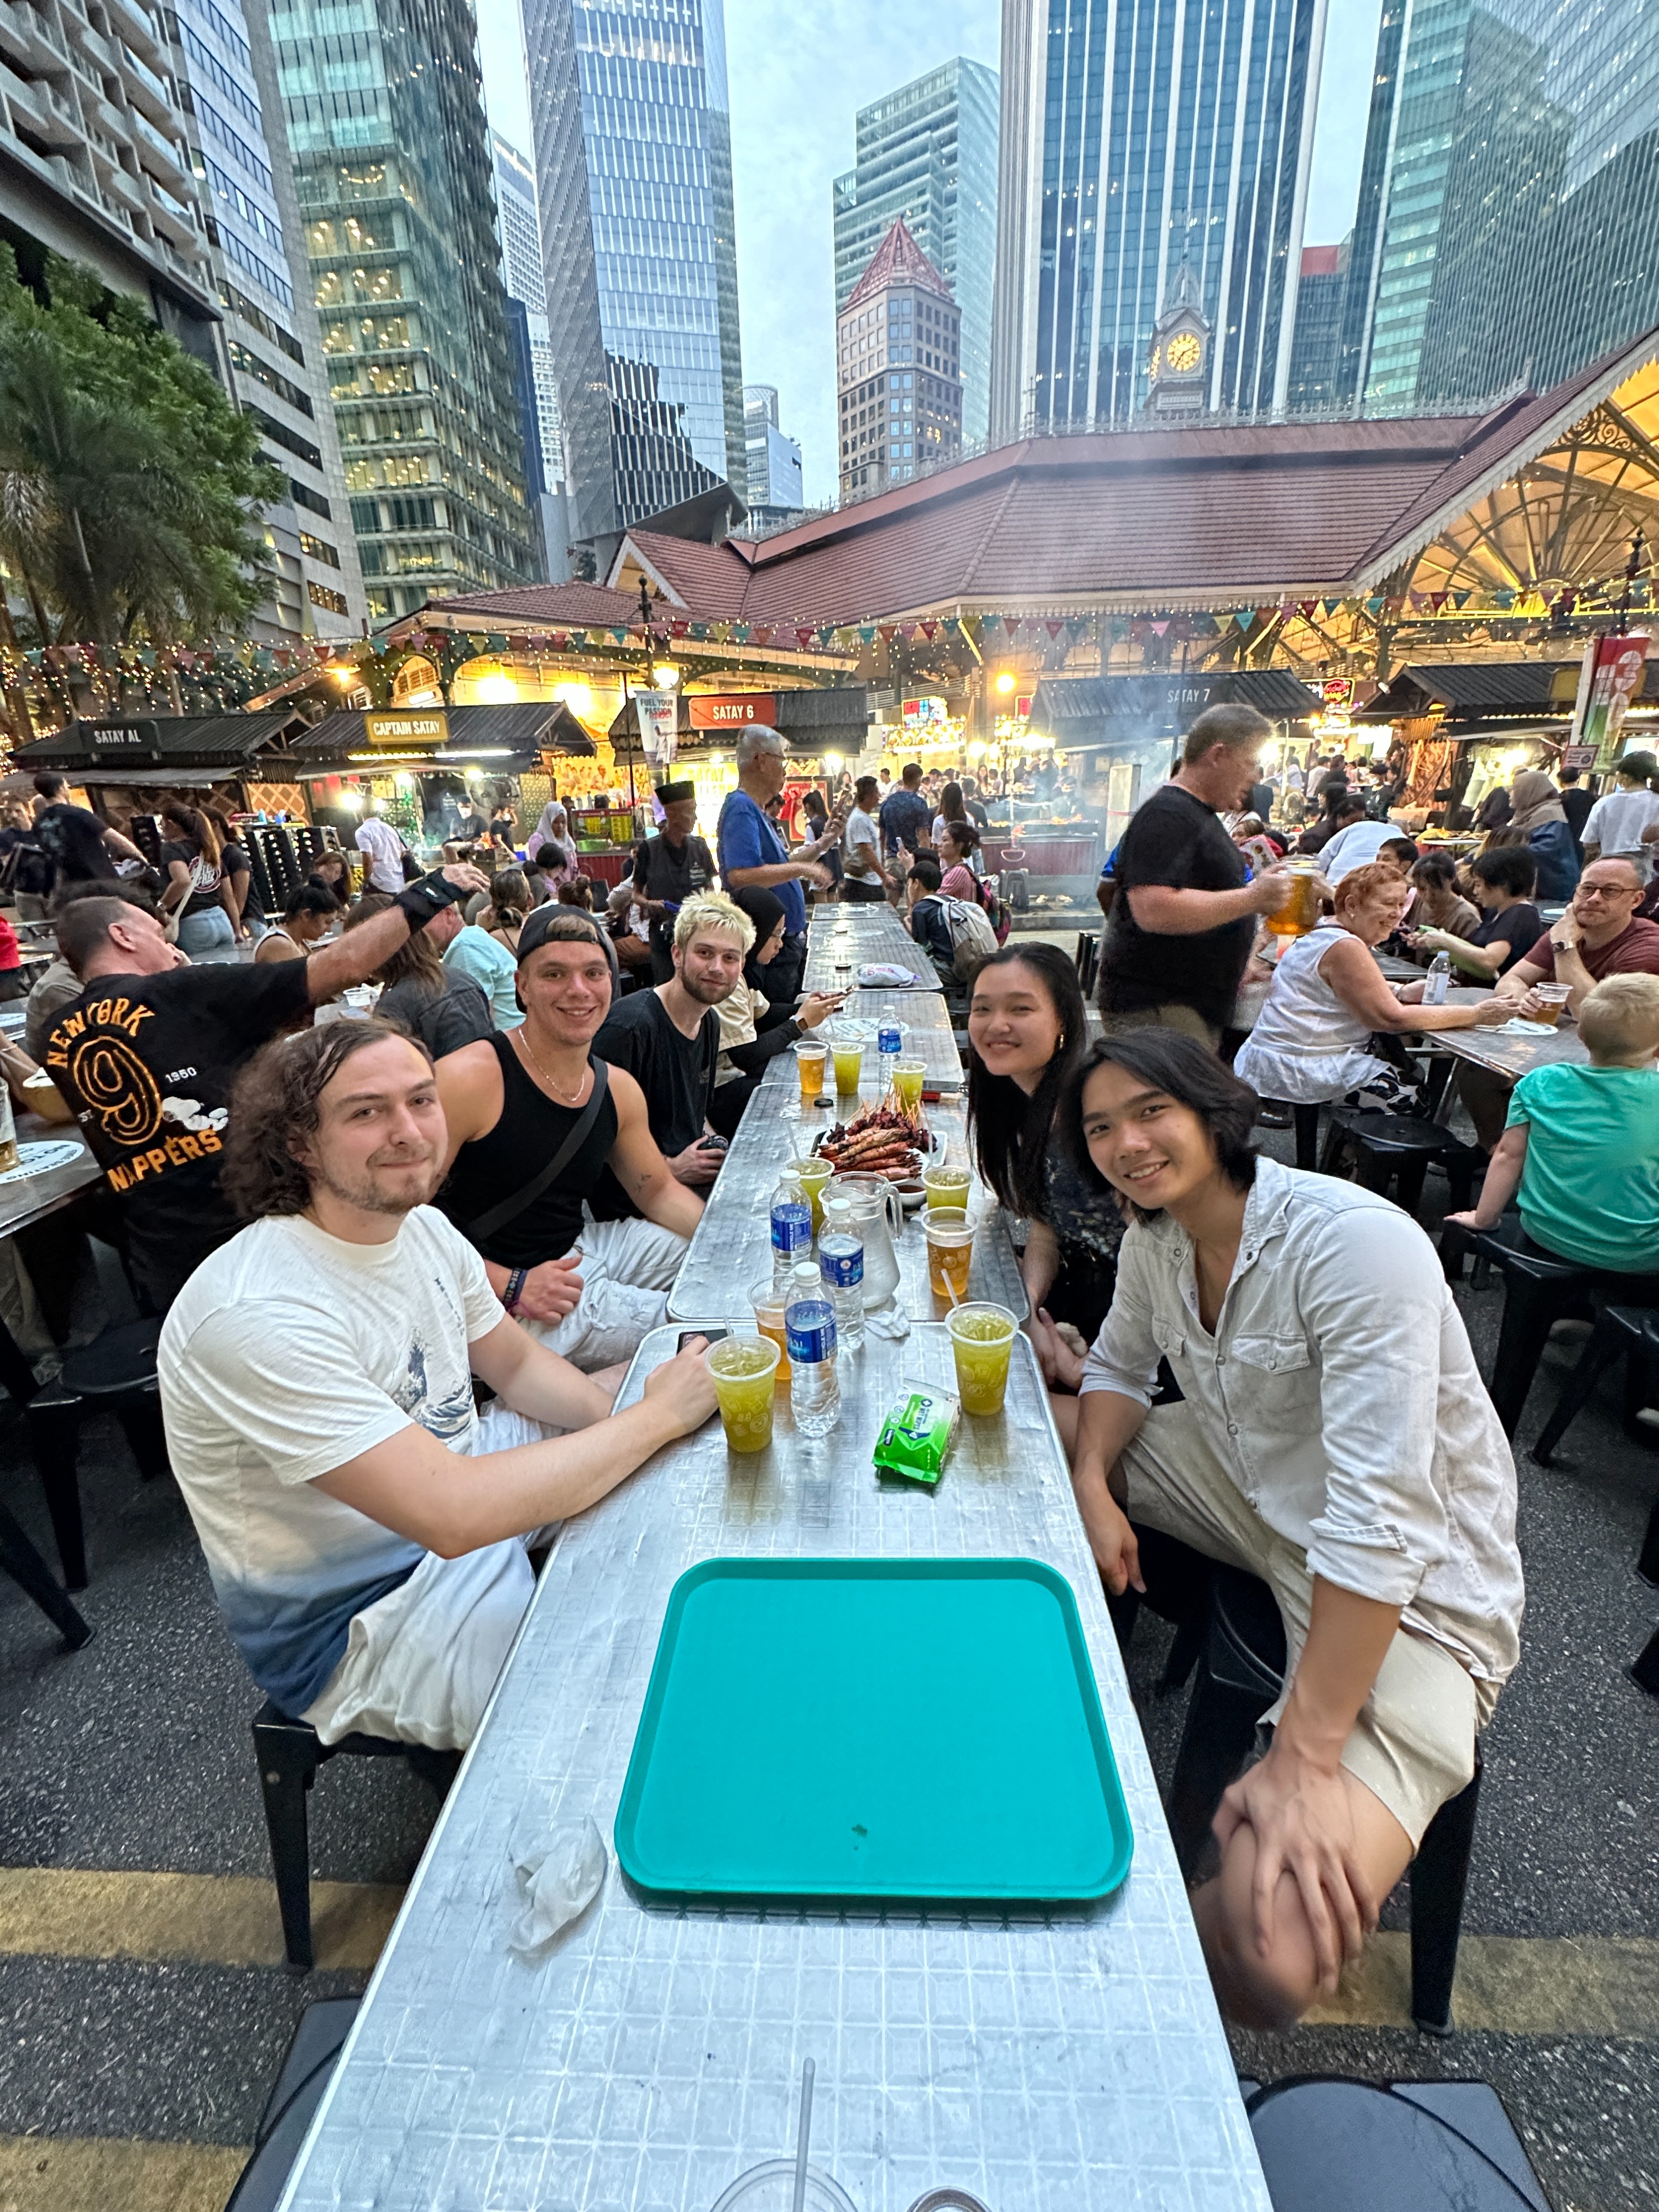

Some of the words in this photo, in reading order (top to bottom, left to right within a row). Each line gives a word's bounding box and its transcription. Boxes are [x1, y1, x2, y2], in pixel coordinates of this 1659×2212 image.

[1167, 689, 1199, 703] SATAY
[1204, 688, 1211, 702] 7
[713, 705, 743, 720] SATAY
[747, 705, 754, 719] 6
[373, 721, 412, 735] CAPTAIN
[413, 721, 440, 734] SATAY
[94, 729, 124, 744] SATAY
[128, 729, 142, 742] AL
[47, 1011, 87, 1069] NEW
[87, 998, 155, 1037] YORK
[73, 1035, 163, 1145] 9
[913, 1416, 923, 1430] WIPES
